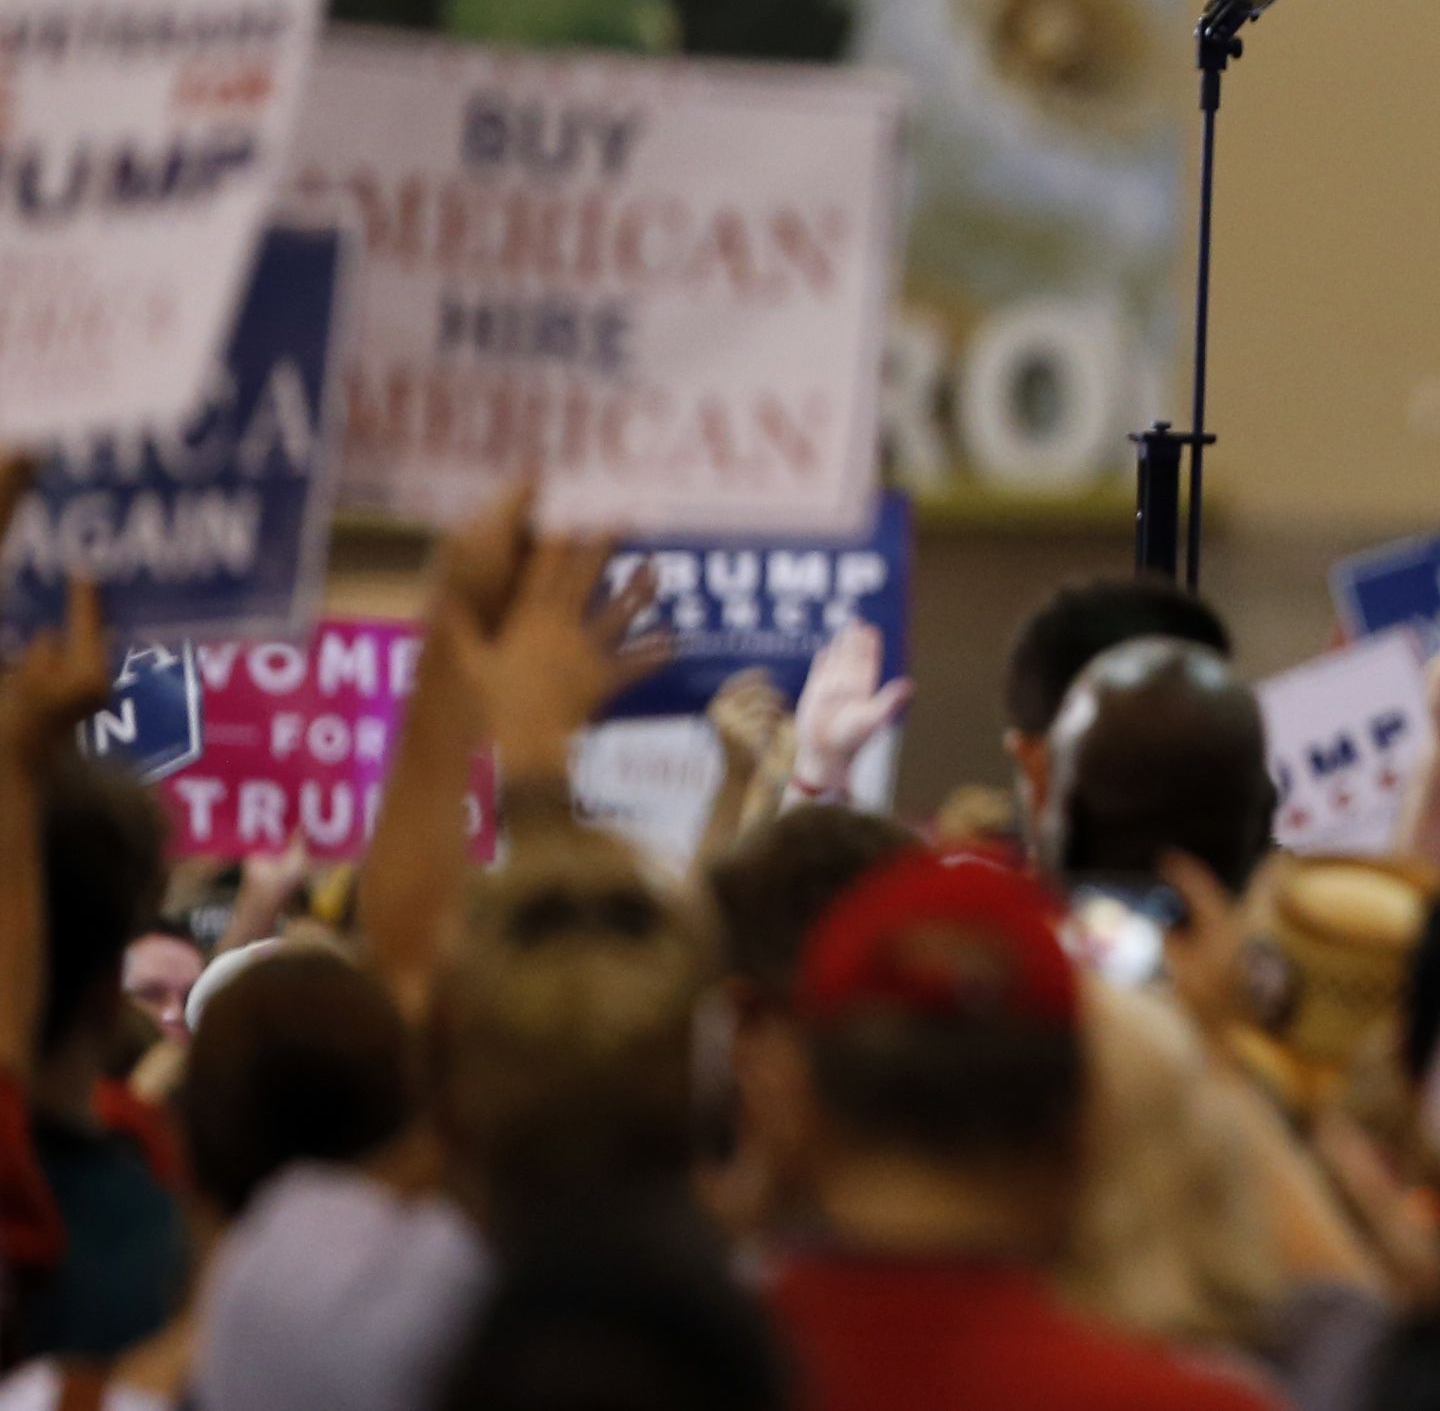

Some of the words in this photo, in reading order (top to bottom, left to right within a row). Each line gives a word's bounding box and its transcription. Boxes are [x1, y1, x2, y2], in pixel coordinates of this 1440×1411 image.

[0, 129, 258, 229] UMP
[458, 89, 648, 179] BUY
[340, 367, 836, 479] MERICAN
